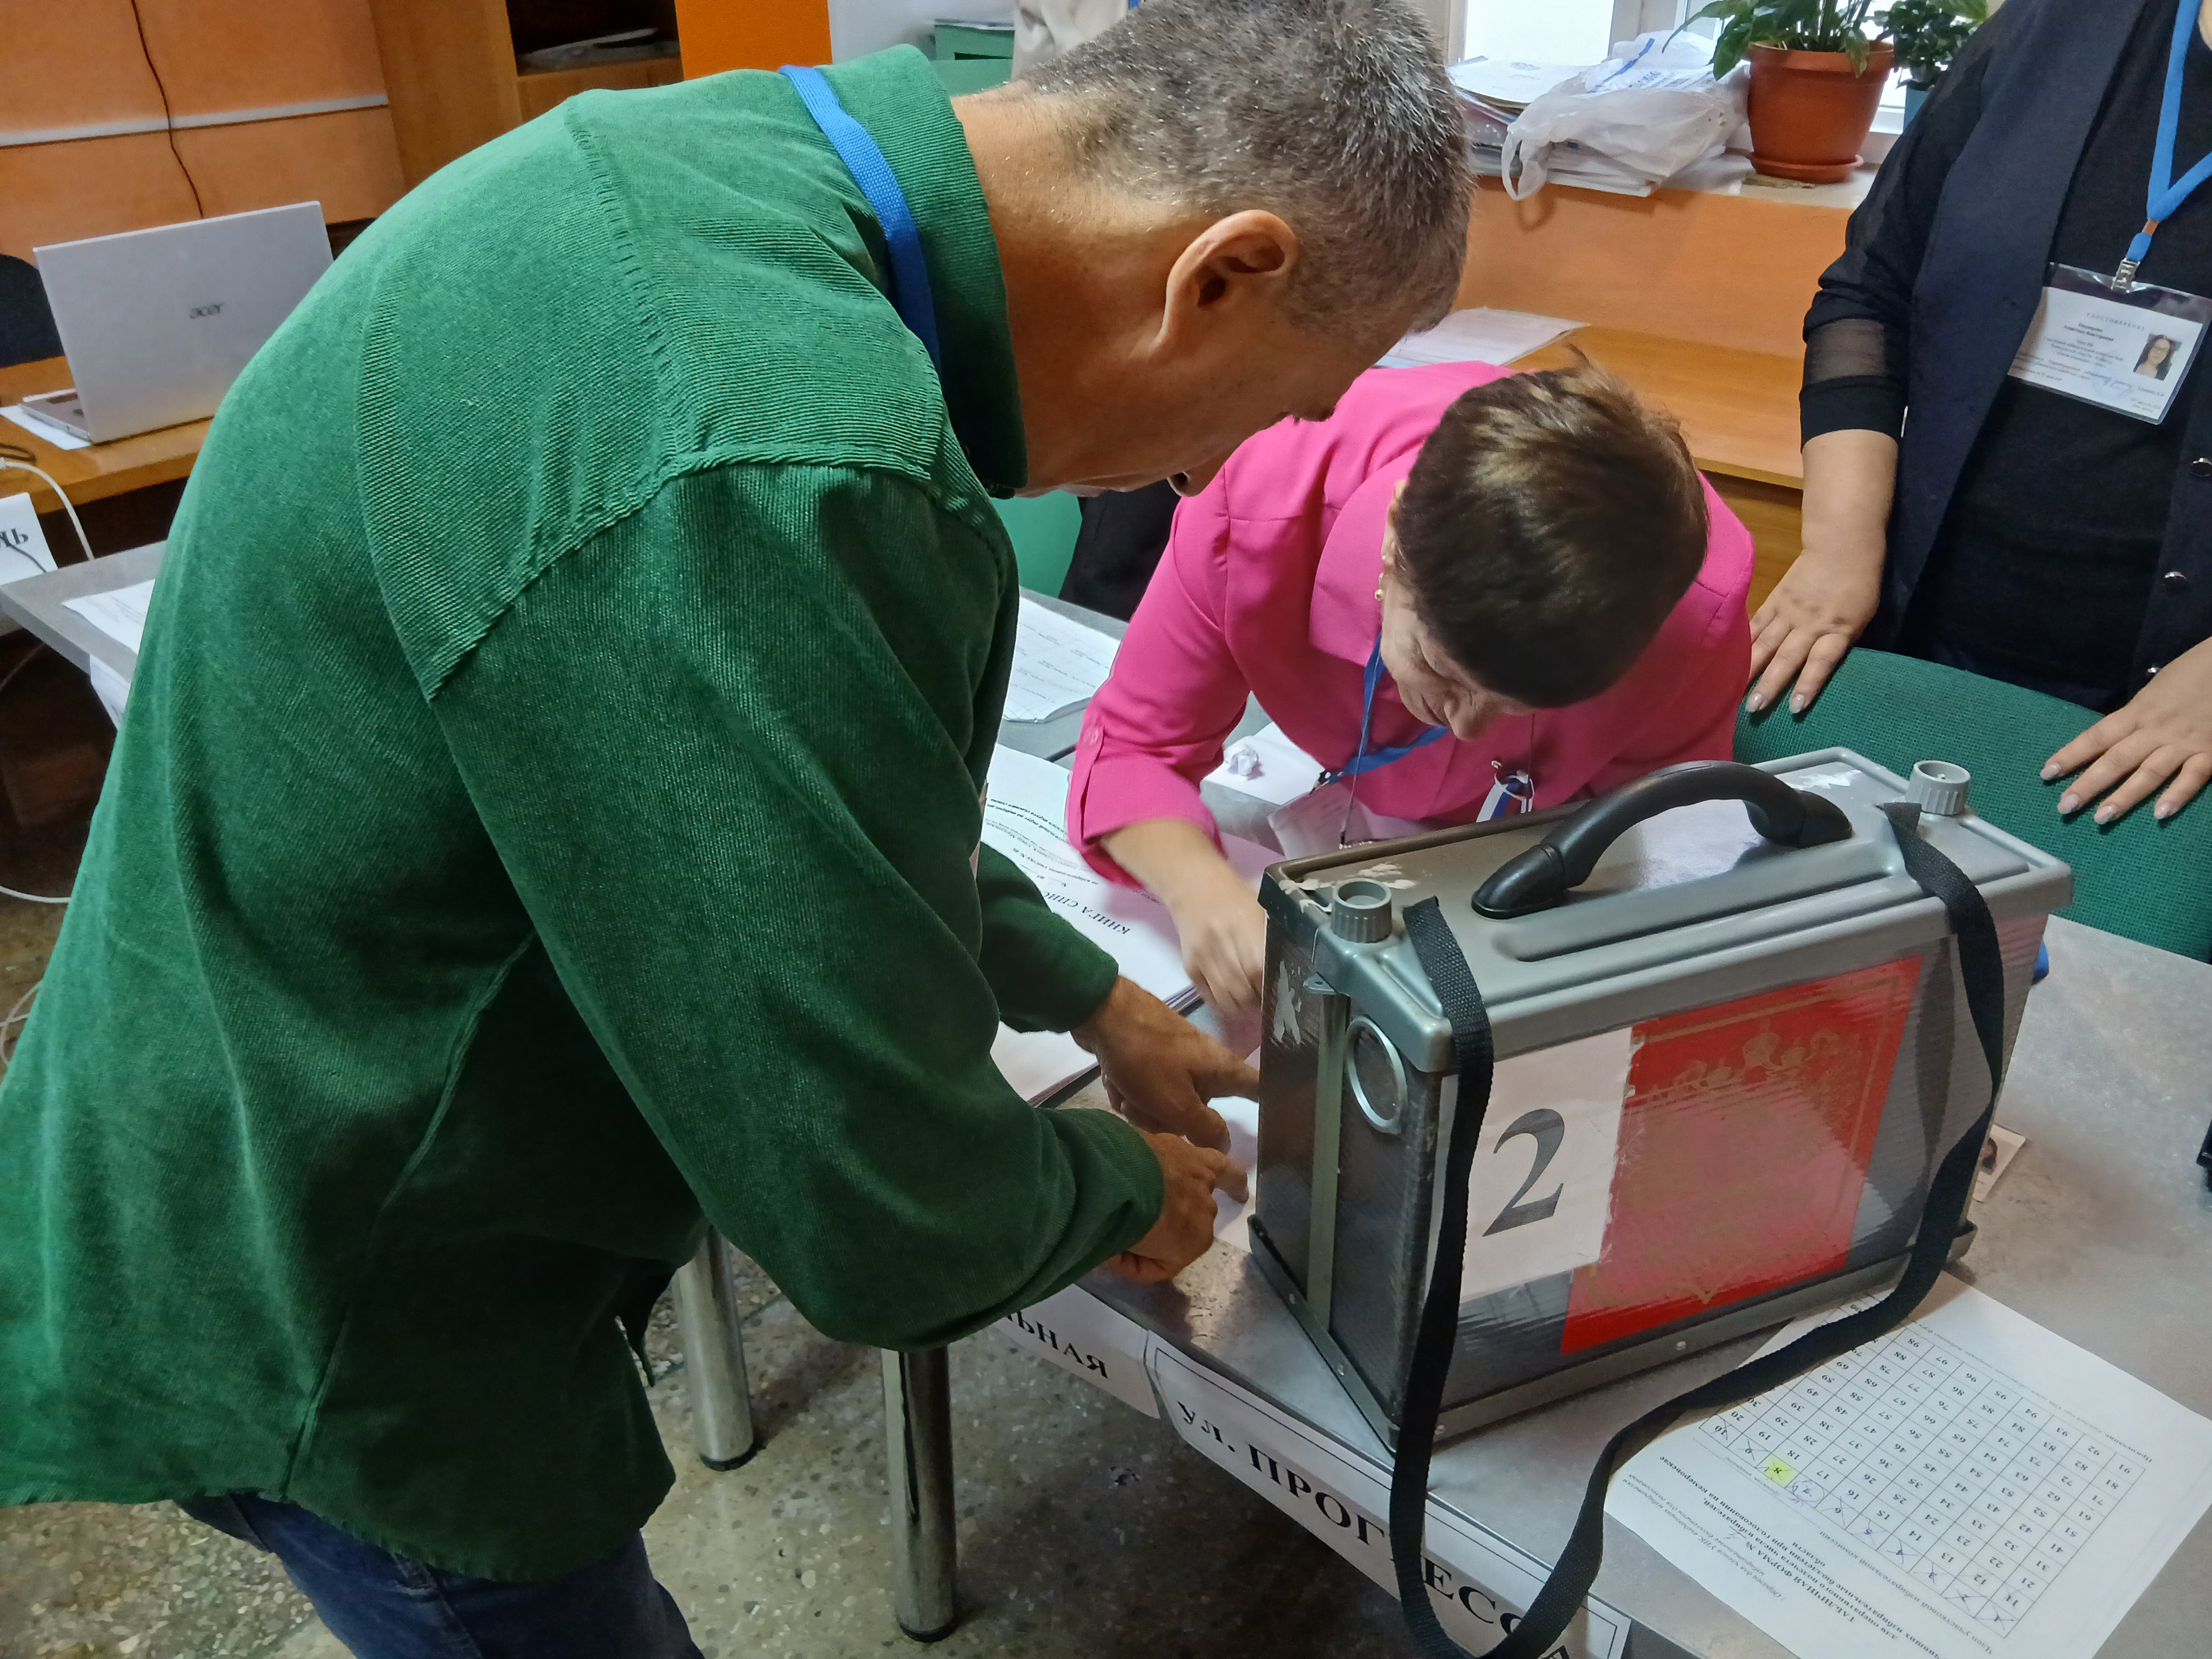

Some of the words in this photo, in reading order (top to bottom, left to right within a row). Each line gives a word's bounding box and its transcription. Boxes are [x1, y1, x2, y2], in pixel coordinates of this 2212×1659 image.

[189, 302, 225, 320] acer
[1082, 906, 1130, 934] КНИГА
[1482, 1108, 1565, 1237] 2
[1907, 1338, 1919, 1348] 98
[1893, 1351, 1907, 1361] 88
[1934, 1355, 1948, 1365] 97
[1836, 1361, 1849, 1369] 69
[1879, 1364, 1891, 1374] 78
[1821, 1374, 1835, 1383] 59
[1921, 1369, 1935, 1378] 87
[1965, 1372, 1977, 1382] 96
[1864, 1378, 1877, 1387] 68
[1907, 1382, 1920, 1393] 77
[1806, 1387, 1819, 1396] 49
[1849, 1391, 1863, 1401] 58
[1952, 1386, 1965, 1396] 86
[1994, 1390, 2007, 1400] 95
[1790, 1402, 1804, 1412] 39
[1892, 1397, 1906, 1406] 67
[1938, 1400, 1949, 1410] 76
[1834, 1405, 1848, 1415] 48
[1980, 1404, 1995, 1414] 85
[2024, 1408, 2037, 1418] 94
[1730, 1411, 1745, 1422] 20
[1774, 1416, 1789, 1426] 29
[1877, 1411, 1892, 1420] 57
[1924, 1414, 1936, 1424] 66
[1818, 1420, 1834, 1430] 38
[1862, 1425, 1877, 1433] 47
[1966, 1418, 1979, 1429] 75
[2011, 1422, 2025, 1432] 84
[1758, 1431, 1771, 1441] 19
[1909, 1429, 1922, 1439] 56
[2056, 1426, 2068, 1437] 93
[1803, 1435, 1817, 1445] 28
[1952, 1433, 1966, 1443] 65
[1997, 1437, 2010, 1448] 74
[1848, 1439, 1863, 1449] 37
[1894, 1443, 1907, 1452] 46
[2043, 1441, 2056, 1451] 83
[1786, 1449, 1800, 1460] 18
[1937, 1448, 1952, 1458] 55
[2087, 1445, 2100, 1456] 92
[1832, 1455, 1847, 1465] 27
[1983, 1452, 1997, 1462] 64
[2029, 1456, 2041, 1467] 73
[1879, 1458, 1893, 1469] 36
[1922, 1463, 1937, 1472] 45
[2074, 1460, 2088, 1471] 82
[2118, 1463, 2130, 1474] 91
[1816, 1470, 1830, 1480] 17
[1969, 1467, 1983, 1477] 54
[2015, 1471, 2029, 1482] 63
[1863, 1473, 1877, 1484] 26
[1907, 1478, 1923, 1489] 35
[2061, 1475, 2073, 1487] 72
[2105, 1478, 2119, 1489] 81
[1954, 1482, 1968, 1492] 44
[2001, 1487, 2015, 1497] 53
[1708, 1492, 1719, 1501] на
[1847, 1489, 1860, 1500] 16
[1892, 1493, 1908, 1504] 25
[2047, 1491, 2061, 1501] 62
[2091, 1494, 2103, 1506] 71
[1939, 1497, 1954, 1509] 34
[1986, 1503, 2000, 1512] 43
[1876, 1509, 1891, 1520] 15
[2033, 1506, 2047, 1517] 52
[2078, 1510, 2091, 1521] 61
[1719, 1500, 1771, 1539] голосовании
[1924, 1513, 1939, 1525] 24
[1971, 1519, 1986, 1530] 33
[2018, 1523, 2033, 1533] 42
[2064, 1527, 2078, 1538] 51
[1908, 1530, 1922, 1541] 14
[1956, 1535, 1971, 1546] 23
[1745, 1541, 1757, 1551] №
[1754, 1536, 1778, 1556] числа
[1771, 1538, 1788, 1551] при
[1819, 1531, 1859, 1559] комиссии
[2003, 1539, 2019, 1551] 32
[2050, 1542, 2063, 1553] 41
[1791, 1541, 1825, 1567] области
[1940, 1552, 1954, 1563] 13
[1757, 1549, 1792, 1577] ФОРМА
[1789, 1550, 1835, 1585] бюллетени
[1989, 1556, 2004, 1568] 22
[2035, 1560, 2049, 1572] 31
[1780, 1555, 1818, 1584] подсчета
[1858, 1558, 1920, 1602] избирательной
[2021, 1577, 2035, 1589] 21
[1793, 1576, 1855, 1622] ТАБЛИЧНАЯ
[1818, 1582, 1879, 1627] оперативного
[1835, 1584, 1903, 1633] избирательные
[1920, 1601, 1971, 1636] участковой
[1970, 1635, 1992, 1655] Член
